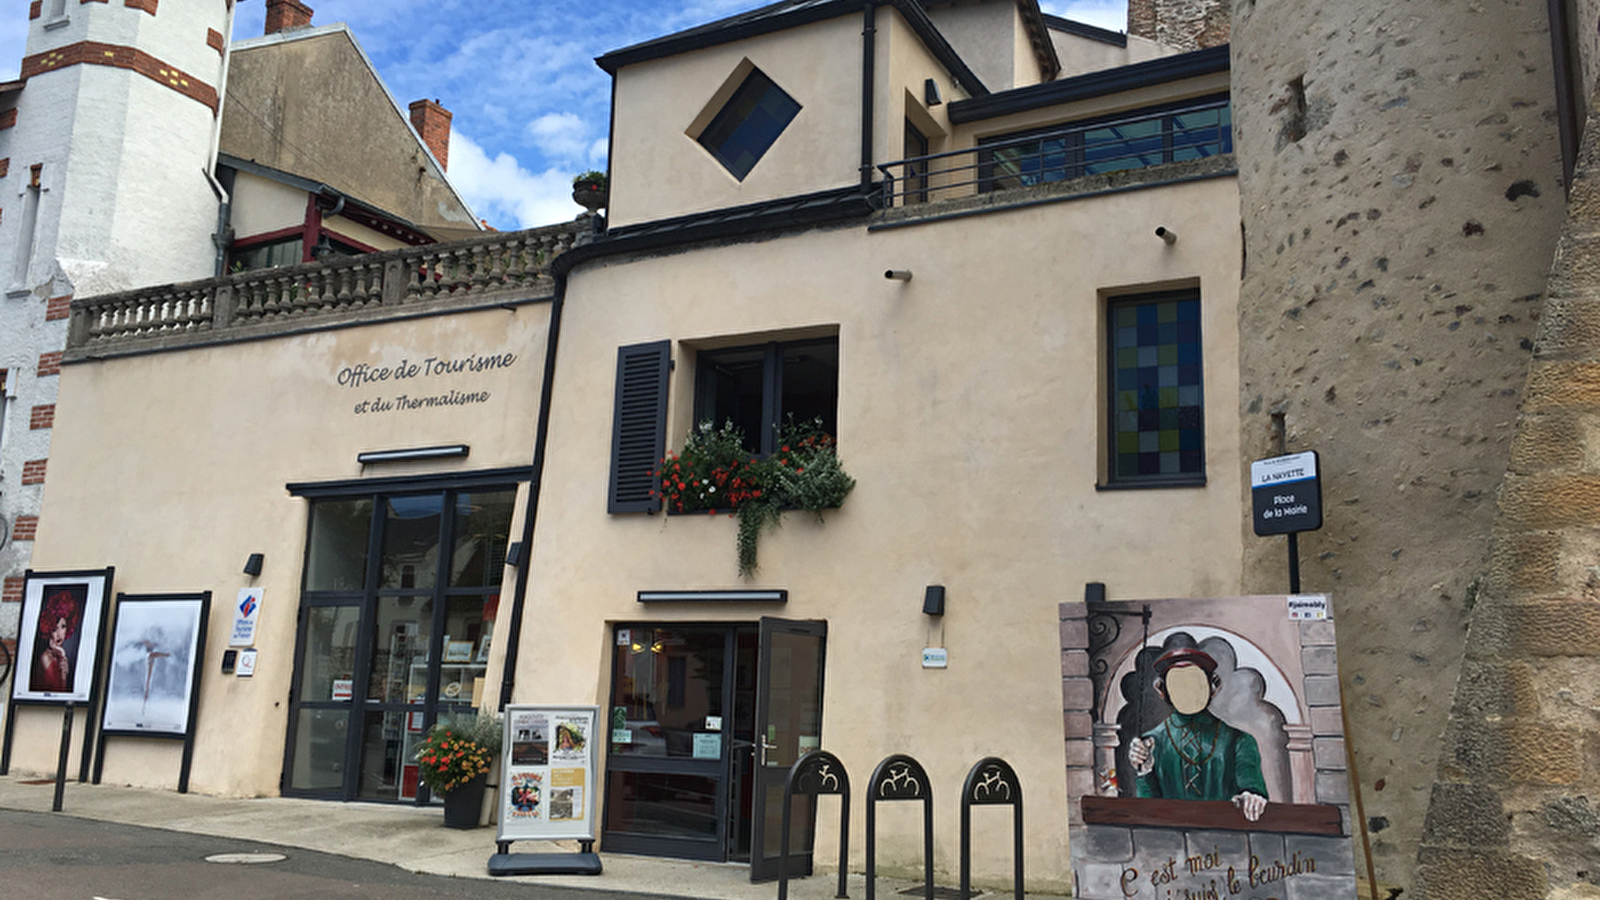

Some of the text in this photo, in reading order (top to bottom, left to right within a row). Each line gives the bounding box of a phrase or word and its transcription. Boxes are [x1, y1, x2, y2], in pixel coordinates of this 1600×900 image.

[338, 352, 517, 388] Office de Tourisme
[354, 389, 491, 415] et du Thermalisme
[1261, 474, 1271, 483] LA
[1263, 504, 1308, 519] de la Mairie
[1273, 493, 1295, 504] Place
[1150, 856, 1178, 887] est
[1185, 845, 1223, 877] moi
[1227, 865, 1242, 896] le
[1248, 850, 1317, 889] beurdin
